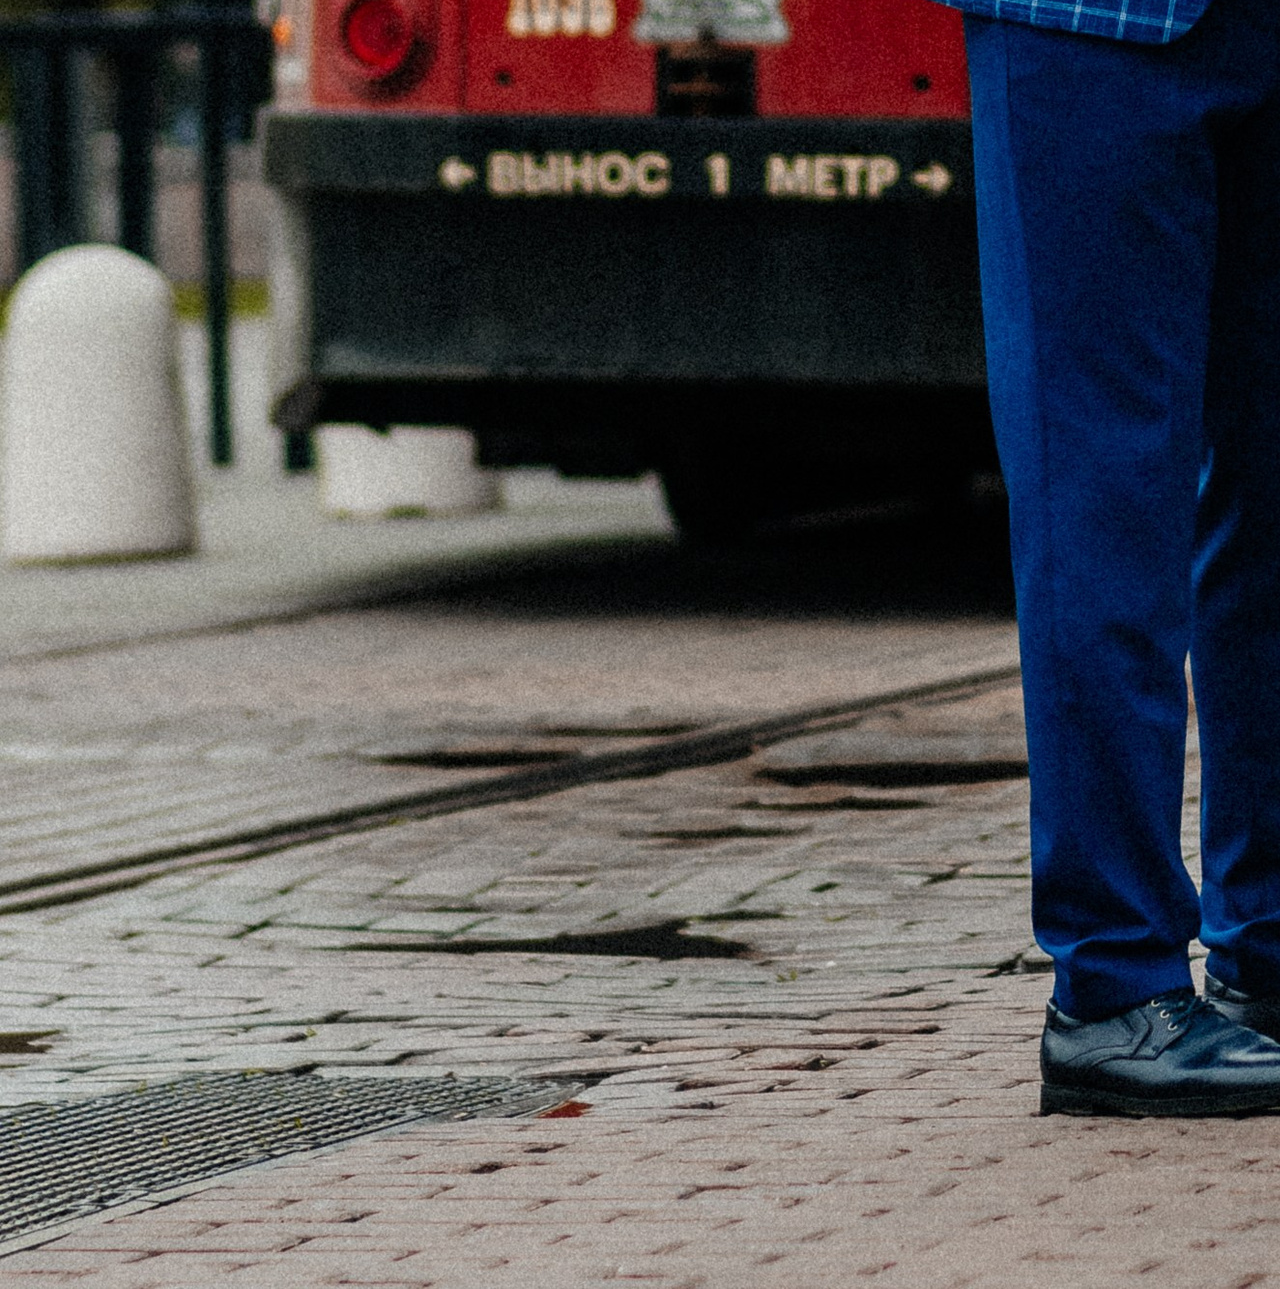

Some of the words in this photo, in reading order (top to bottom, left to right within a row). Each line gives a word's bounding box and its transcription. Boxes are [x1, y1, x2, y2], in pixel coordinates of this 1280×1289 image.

[488, 152, 670, 196] ВЫНОС
[705, 154, 731, 195] 1
[766, 155, 898, 197] МЕТР
